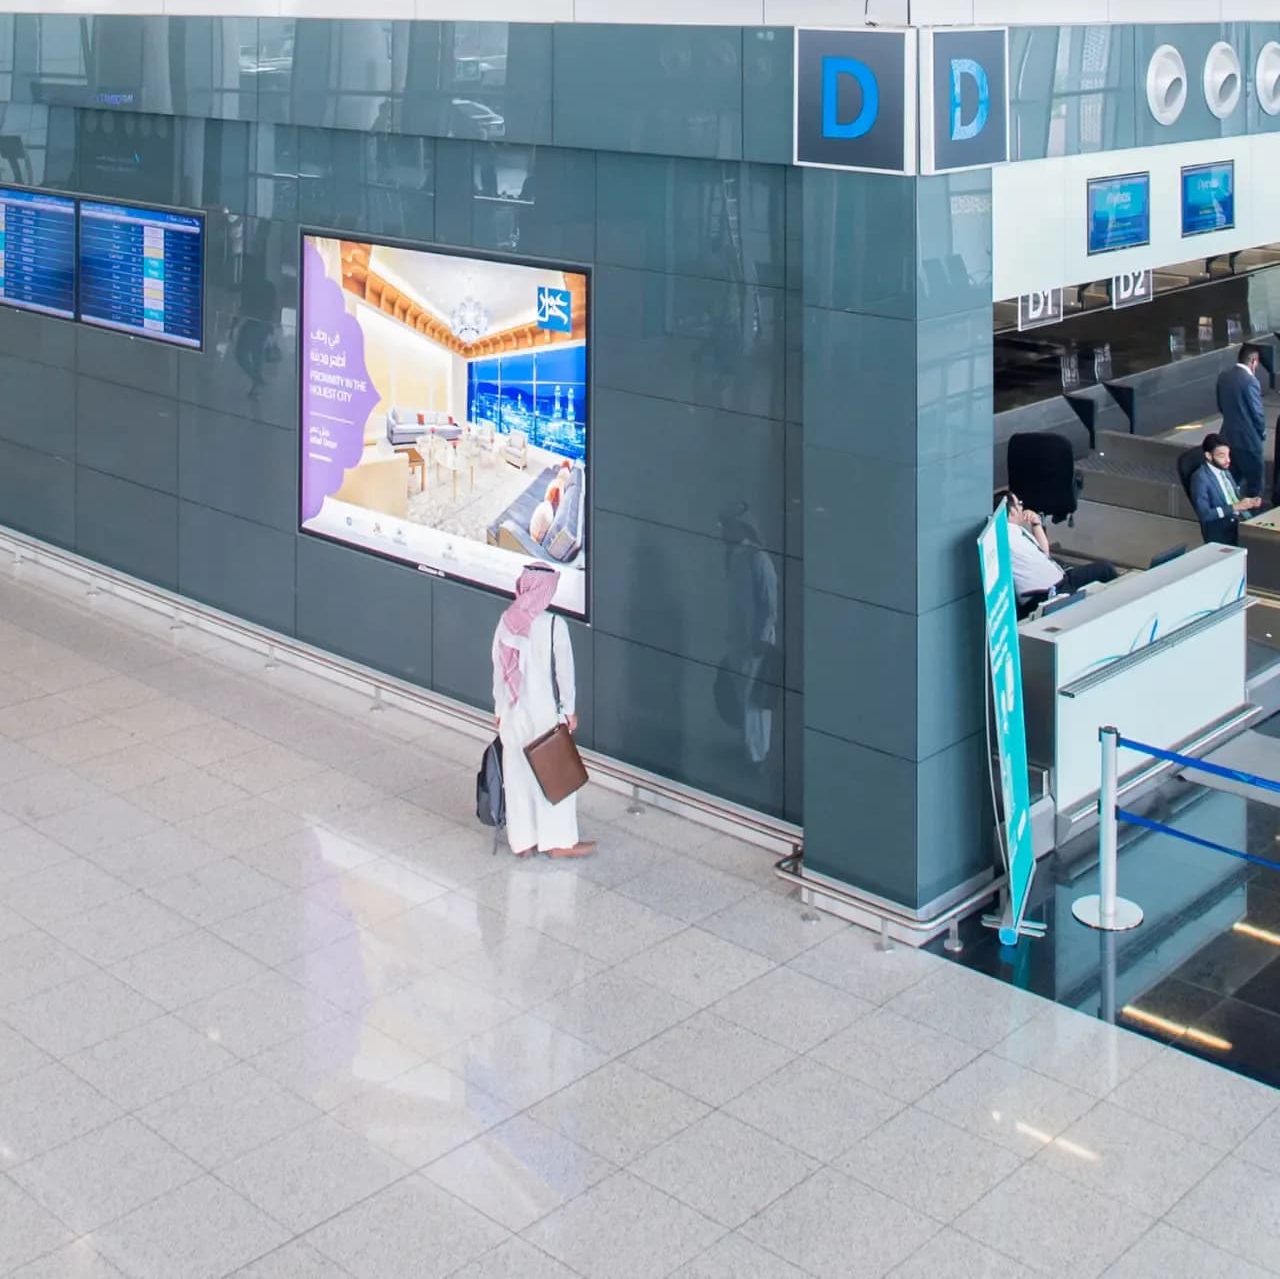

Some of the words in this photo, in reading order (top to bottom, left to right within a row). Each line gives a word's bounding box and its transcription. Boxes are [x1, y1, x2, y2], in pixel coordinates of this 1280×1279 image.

[821, 55, 880, 139] D
[950, 58, 990, 141] D
[1120, 271, 1146, 299] D2
[1028, 289, 1053, 319] D1
[337, 390, 353, 402] CITY
[354, 378, 368, 393] THE
